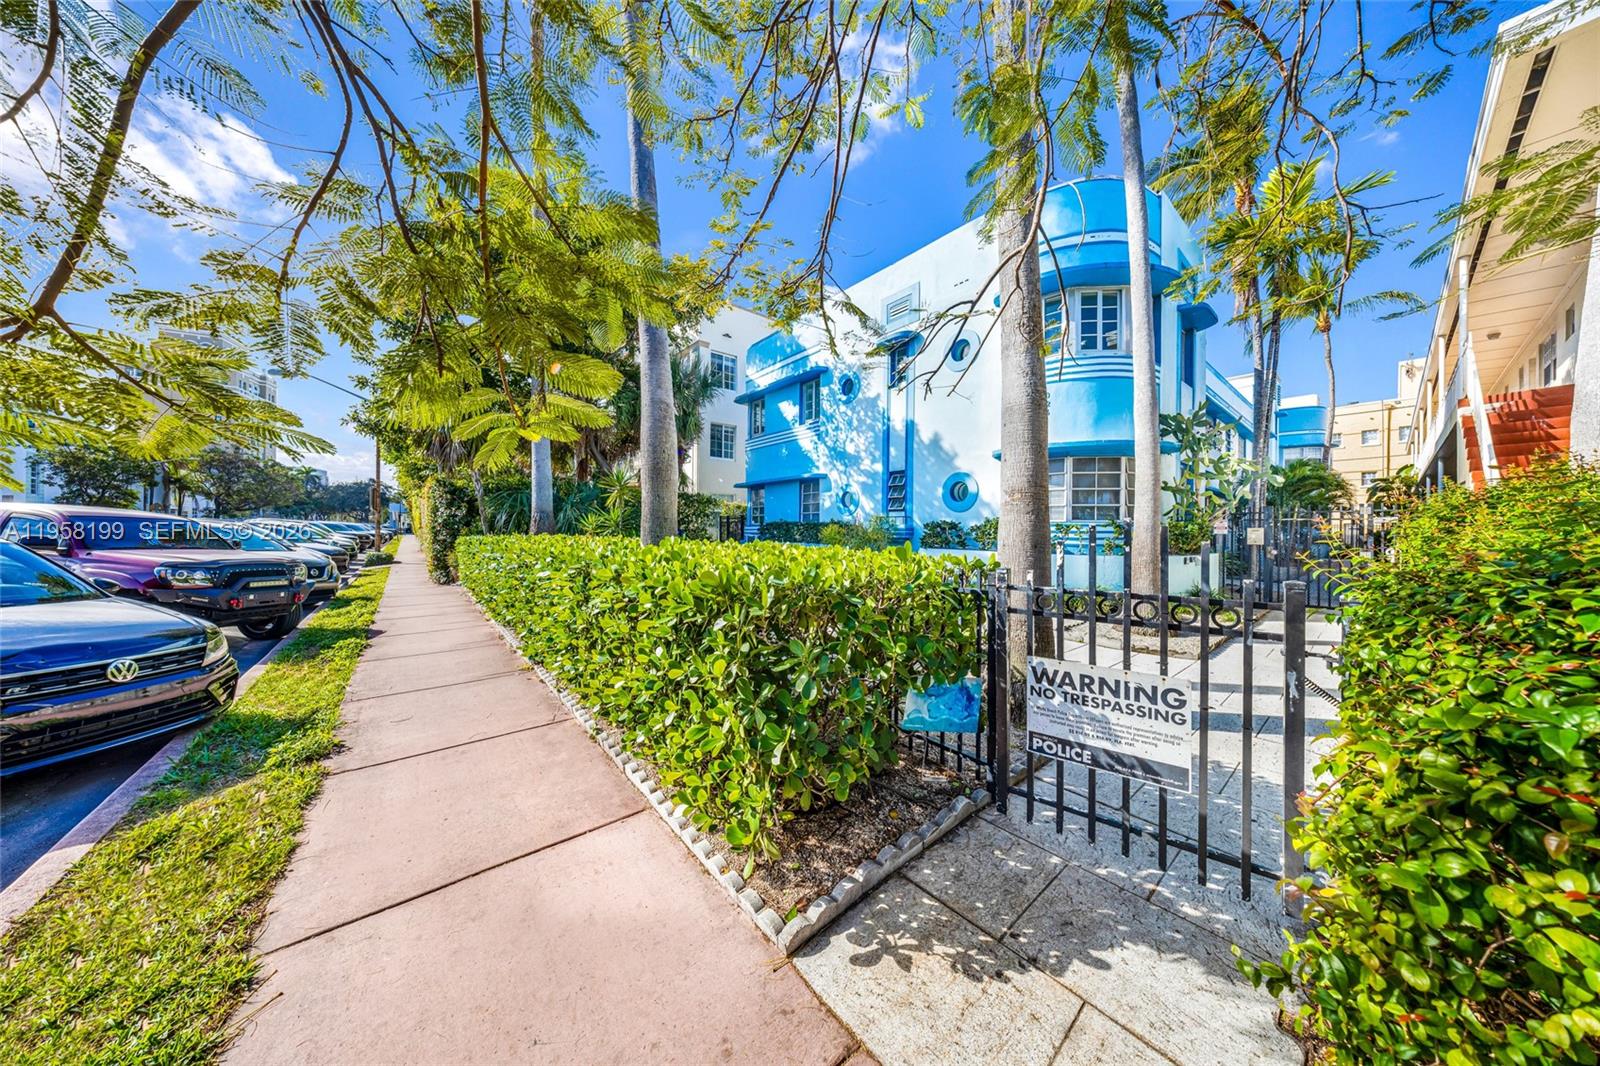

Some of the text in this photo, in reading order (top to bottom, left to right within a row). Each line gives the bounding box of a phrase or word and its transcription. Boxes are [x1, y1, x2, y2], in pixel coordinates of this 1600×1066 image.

[1030, 685, 1056, 700] NO
[1061, 691, 1187, 726] TRESPASSING
[1031, 666, 1188, 710] WARNING
[1032, 738, 1092, 764] POLICE
